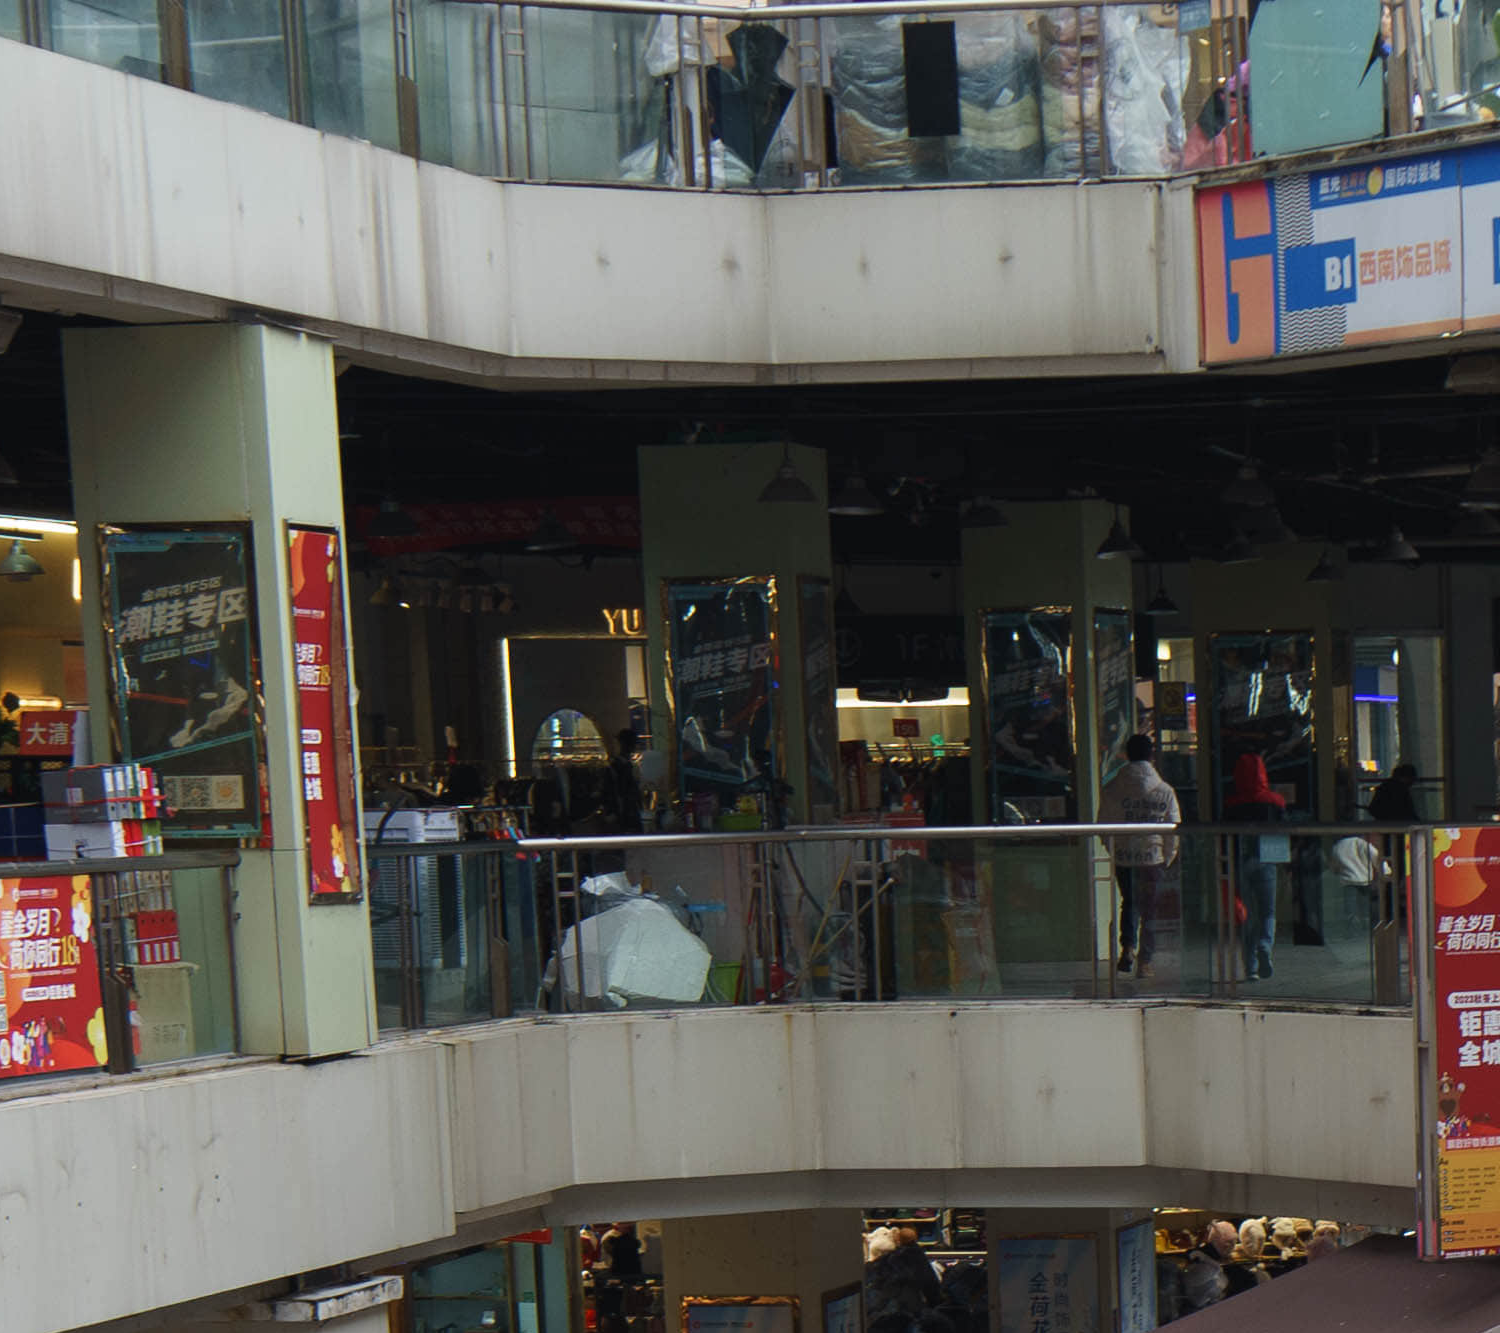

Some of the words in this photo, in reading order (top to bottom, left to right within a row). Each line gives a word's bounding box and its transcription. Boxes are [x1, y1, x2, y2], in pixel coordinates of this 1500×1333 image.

[1324, 253, 1353, 293] B1
[1359, 238, 1453, 286] 西南饰品城
[118, 587, 249, 645] 潮鞋专区
